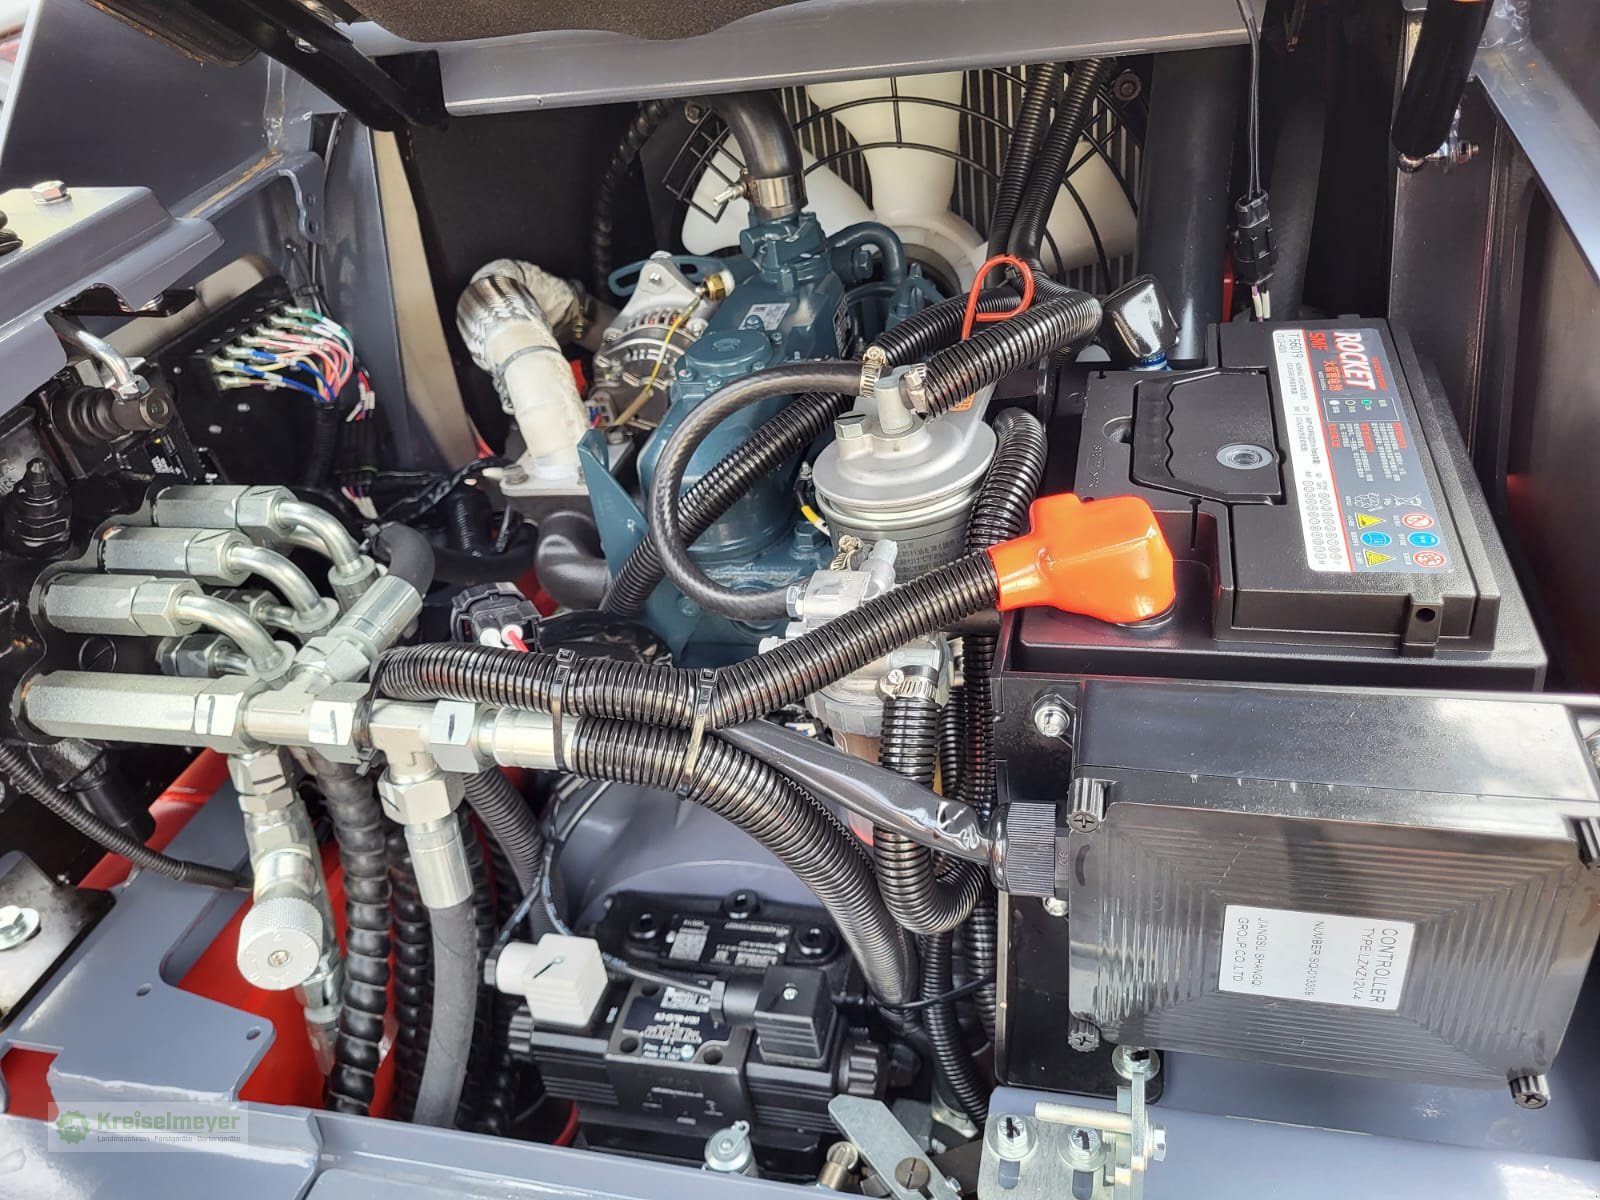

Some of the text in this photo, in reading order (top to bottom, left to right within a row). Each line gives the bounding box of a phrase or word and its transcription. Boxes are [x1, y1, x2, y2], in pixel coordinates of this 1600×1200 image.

[1333, 332, 1376, 390] ROCKET
[1236, 917, 1250, 948] GROUP
[1369, 928, 1398, 1003] CONTROLLER
